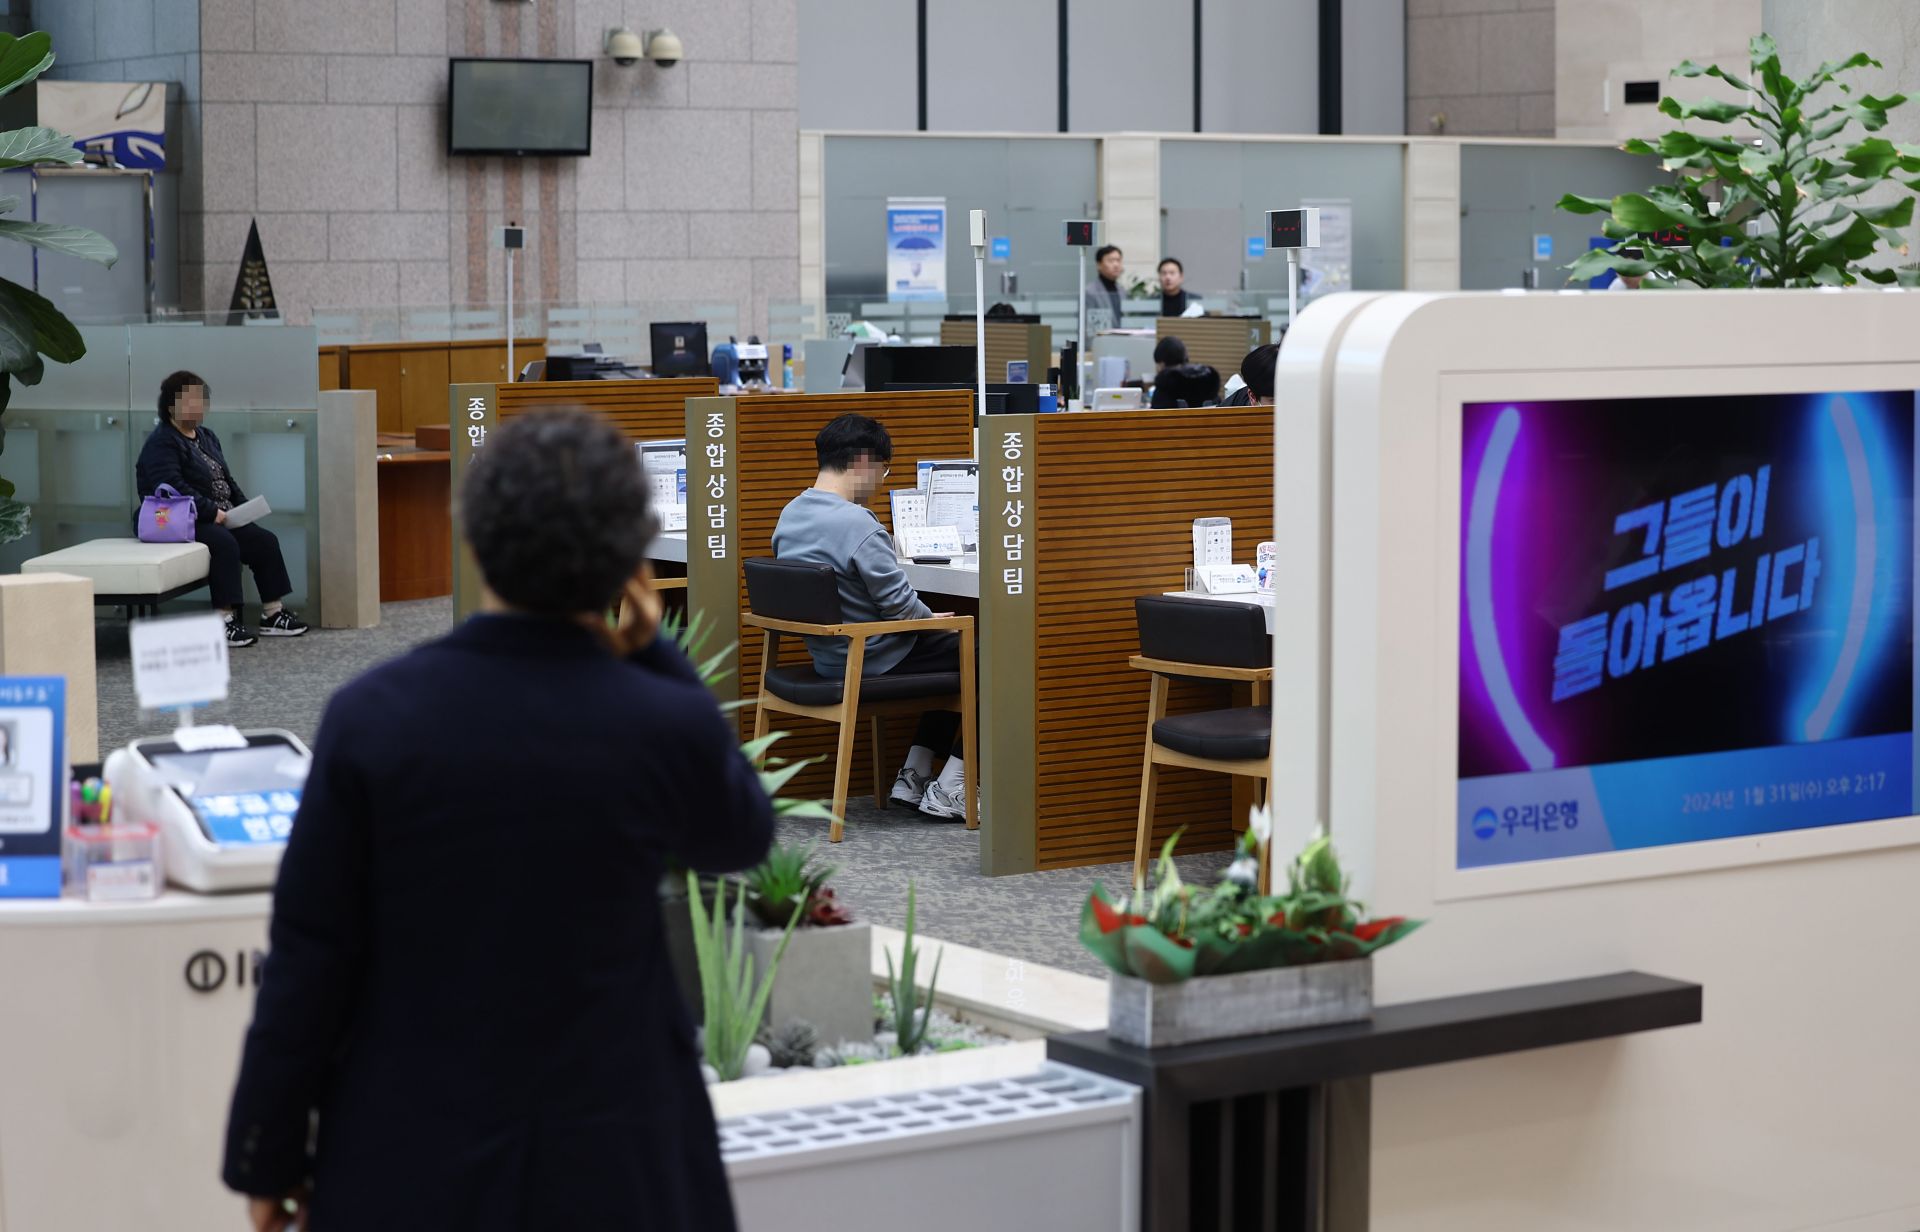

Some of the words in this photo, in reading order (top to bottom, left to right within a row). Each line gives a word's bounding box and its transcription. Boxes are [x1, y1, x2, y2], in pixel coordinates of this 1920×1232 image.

[468, 397, 487, 464] 종합
[705, 413, 727, 559] 종합상담팀
[1002, 432, 1024, 595] 종합상담팀
[1603, 464, 1771, 592] 그들이
[1552, 536, 1821, 703] 돌아옵니다
[1501, 799, 1578, 836] 우리은행
[1682, 789, 1734, 813] 2024년
[1744, 784, 1764, 806] 1월
[1770, 781, 1822, 803] 31일(수)
[1826, 777, 1850, 796] 오후
[1854, 772, 1886, 794] 2:17
